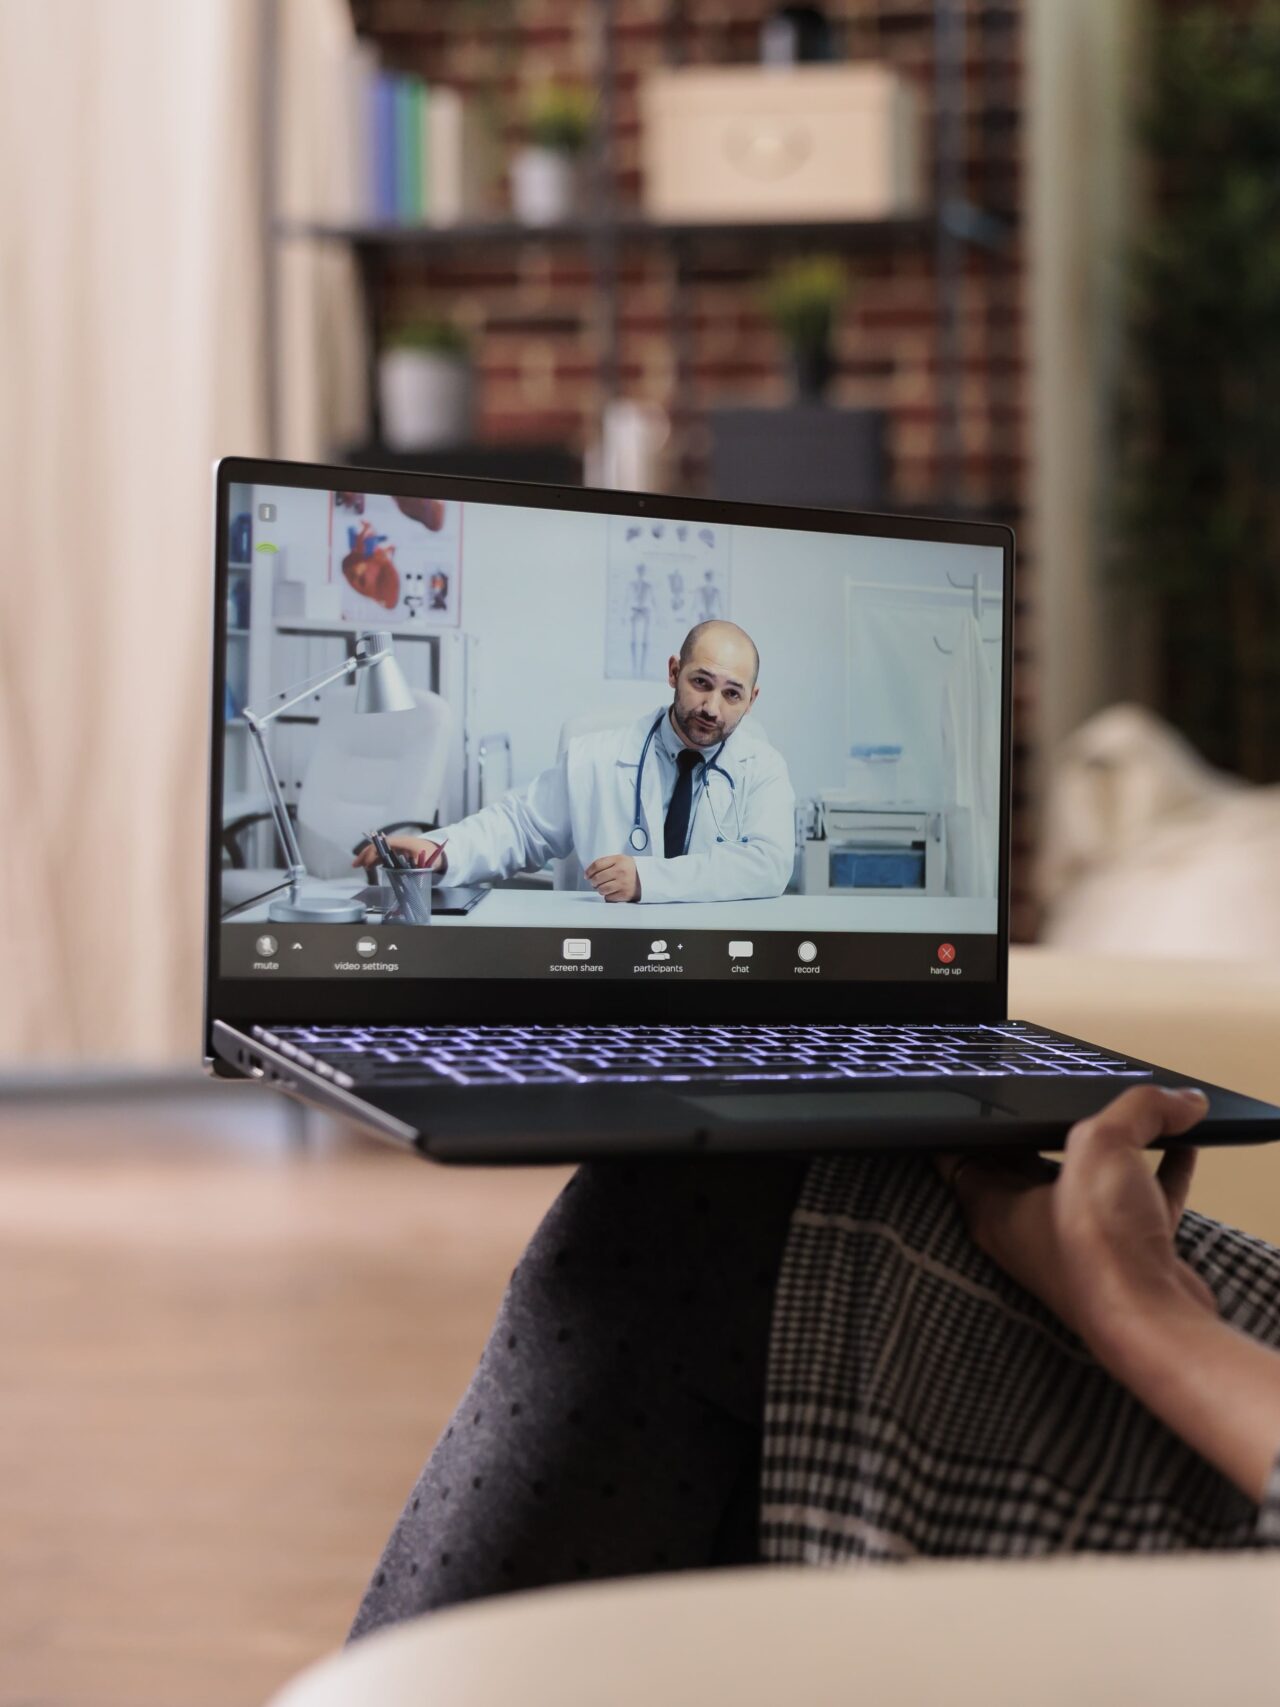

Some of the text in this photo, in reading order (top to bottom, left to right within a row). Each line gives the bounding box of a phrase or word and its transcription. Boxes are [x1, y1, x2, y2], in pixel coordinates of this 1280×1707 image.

[253, 961, 280, 970] mute
[334, 961, 399, 972] video settings
[549, 963, 604, 973] screen share
[633, 963, 684, 974] participants
[731, 964, 750, 973] chat
[794, 965, 820, 974] record
[930, 966, 962, 976] hang up
